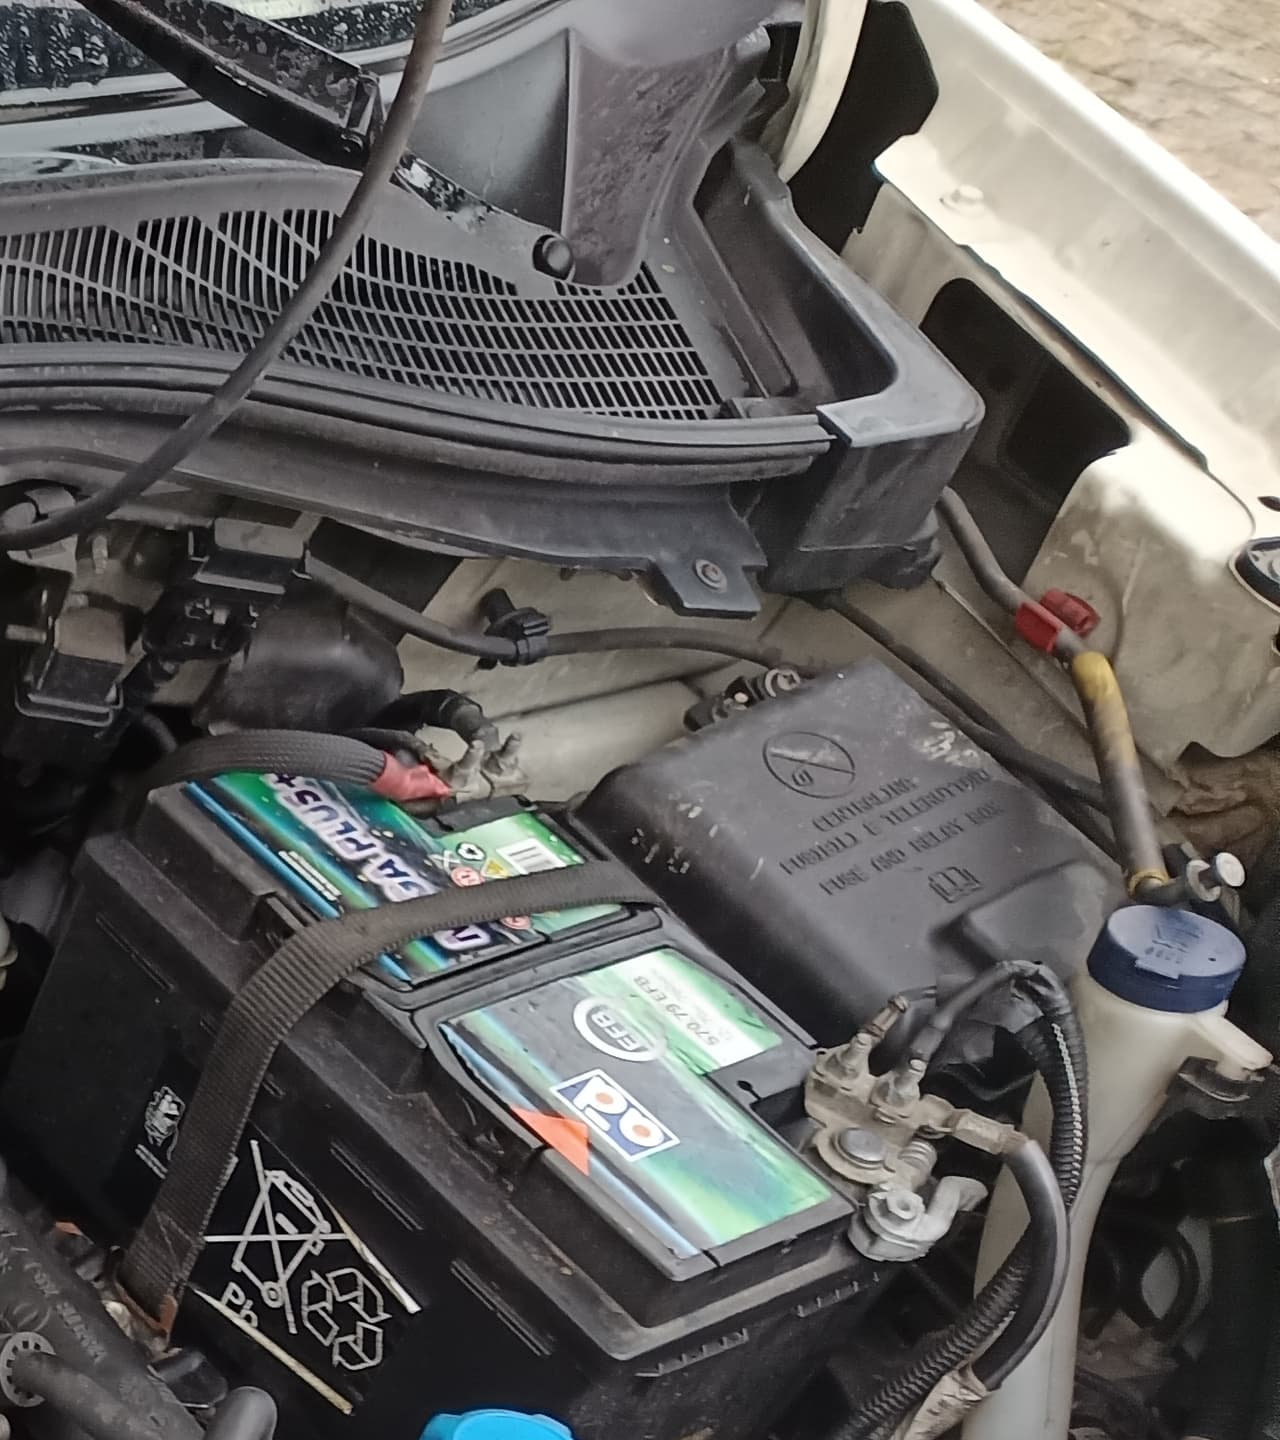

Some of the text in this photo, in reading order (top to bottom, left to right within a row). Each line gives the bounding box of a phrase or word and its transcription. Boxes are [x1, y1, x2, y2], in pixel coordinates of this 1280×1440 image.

[818, 865, 869, 896] FUSE
[870, 848, 907, 873] AND
[907, 818, 965, 853] RELAY
[366, 855, 486, 947] MGA
[633, 974, 668, 1003] EFB
[590, 1008, 641, 1051] EFB
[666, 1003, 721, 1047] 570.79
[220, 1281, 259, 1329] Pb
